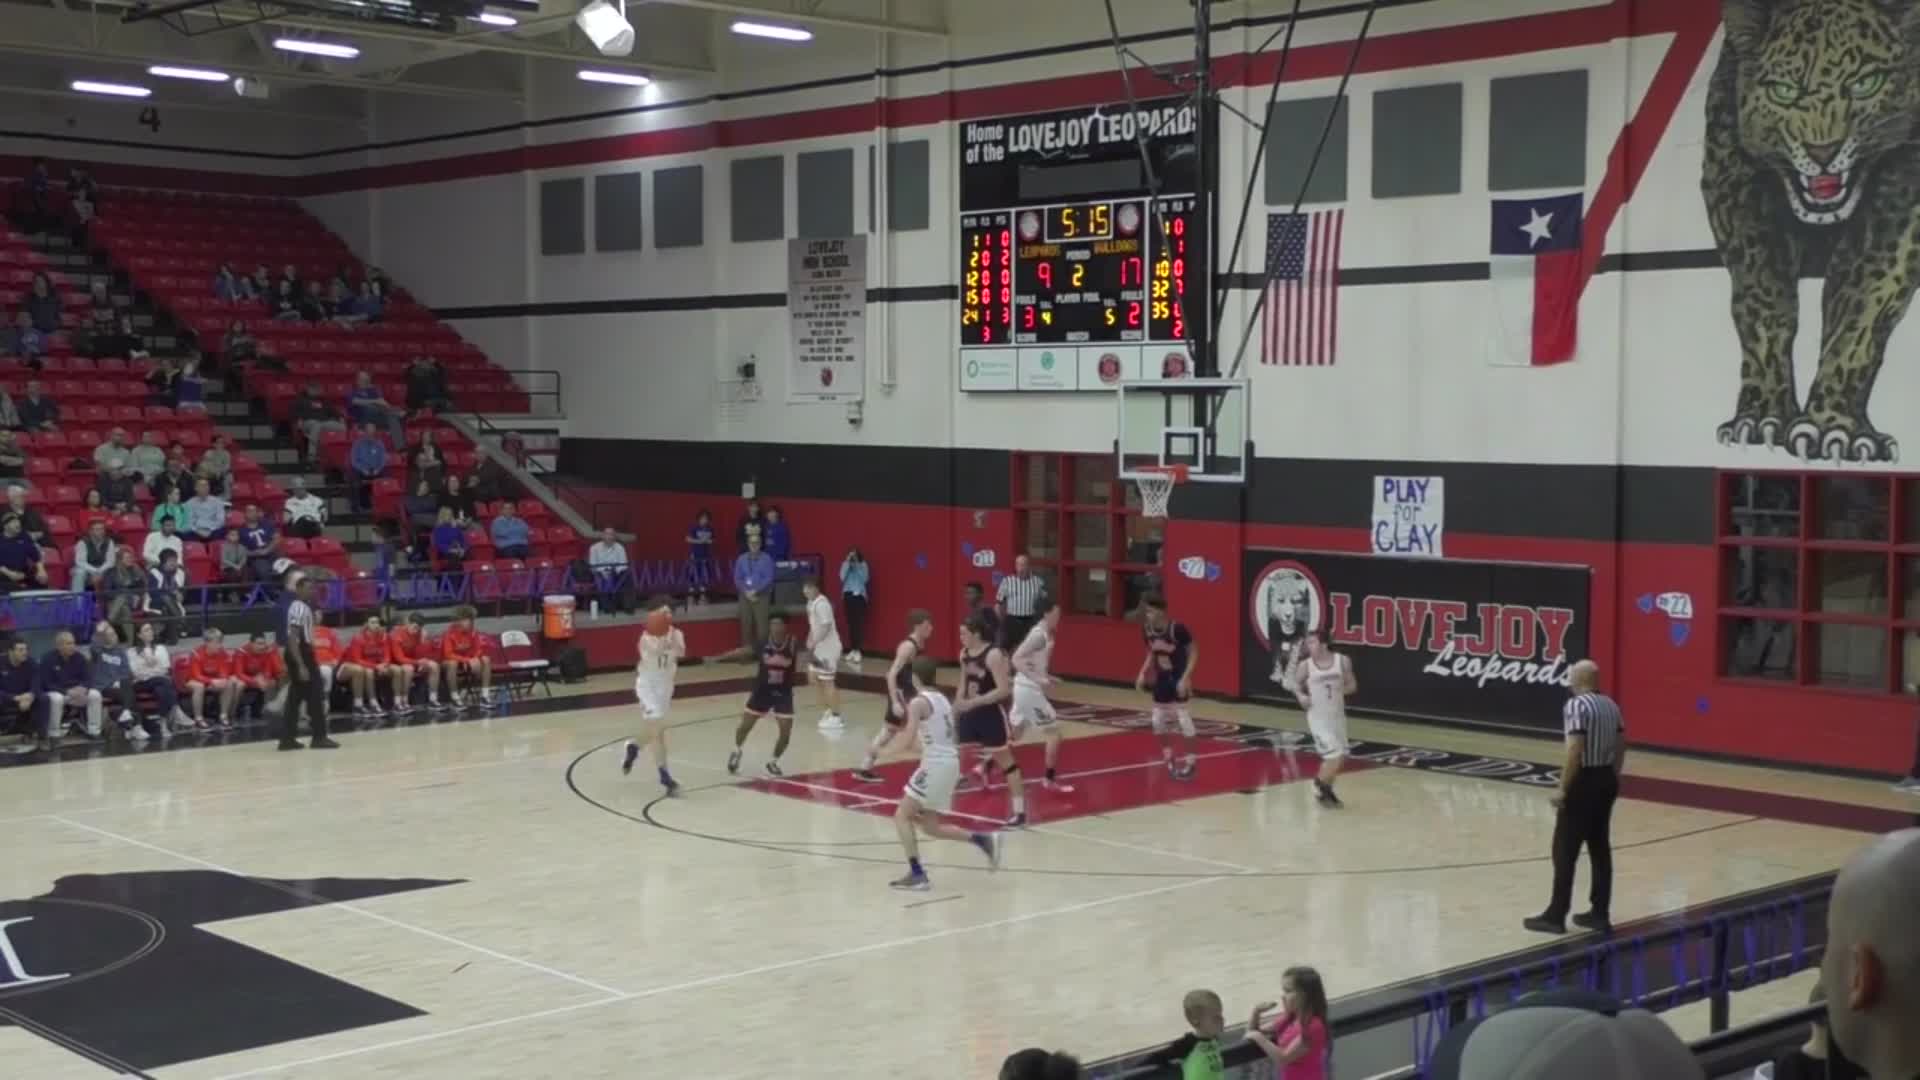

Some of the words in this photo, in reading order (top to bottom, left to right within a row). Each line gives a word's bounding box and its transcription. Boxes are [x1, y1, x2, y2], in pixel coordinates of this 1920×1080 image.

[140, 107, 160, 132] 4
[967, 124, 1004, 144] Home
[1009, 117, 1092, 153] LOVEJOY
[966, 148, 979, 164] of
[983, 145, 1004, 162] the
[1062, 206, 1108, 237] 5:15
[1173, 217, 1184, 235] 0
[1001, 230, 1010, 247] 0
[970, 251, 979, 267] 2
[981, 250, 990, 266] 0
[1001, 249, 1009, 265] 2
[1155, 259, 1170, 277] 10
[1173, 258, 1184, 277] 0
[966, 271, 979, 287] 12
[1001, 269, 1010, 285] 0
[1038, 262, 1051, 289] 9
[1072, 264, 1084, 287] 2
[1121, 257, 1142, 285] 17
[966, 288, 979, 305] 15
[1001, 287, 1010, 304] 0
[1152, 280, 1170, 298] 32
[1001, 307, 1010, 323] 3
[1024, 306, 1035, 328] 3
[1041, 311, 1052, 325] 4
[1105, 308, 1116, 325] 5
[1129, 302, 1141, 325] 2
[1152, 301, 1170, 319] 35
[983, 326, 991, 342] 3
[1173, 320, 1183, 337] 2
[1383, 476, 1431, 504] PLAY
[1375, 519, 1438, 554] CLAY
[1330, 592, 1574, 663] LOVEJOY
[1424, 640, 1572, 688] Leopards
